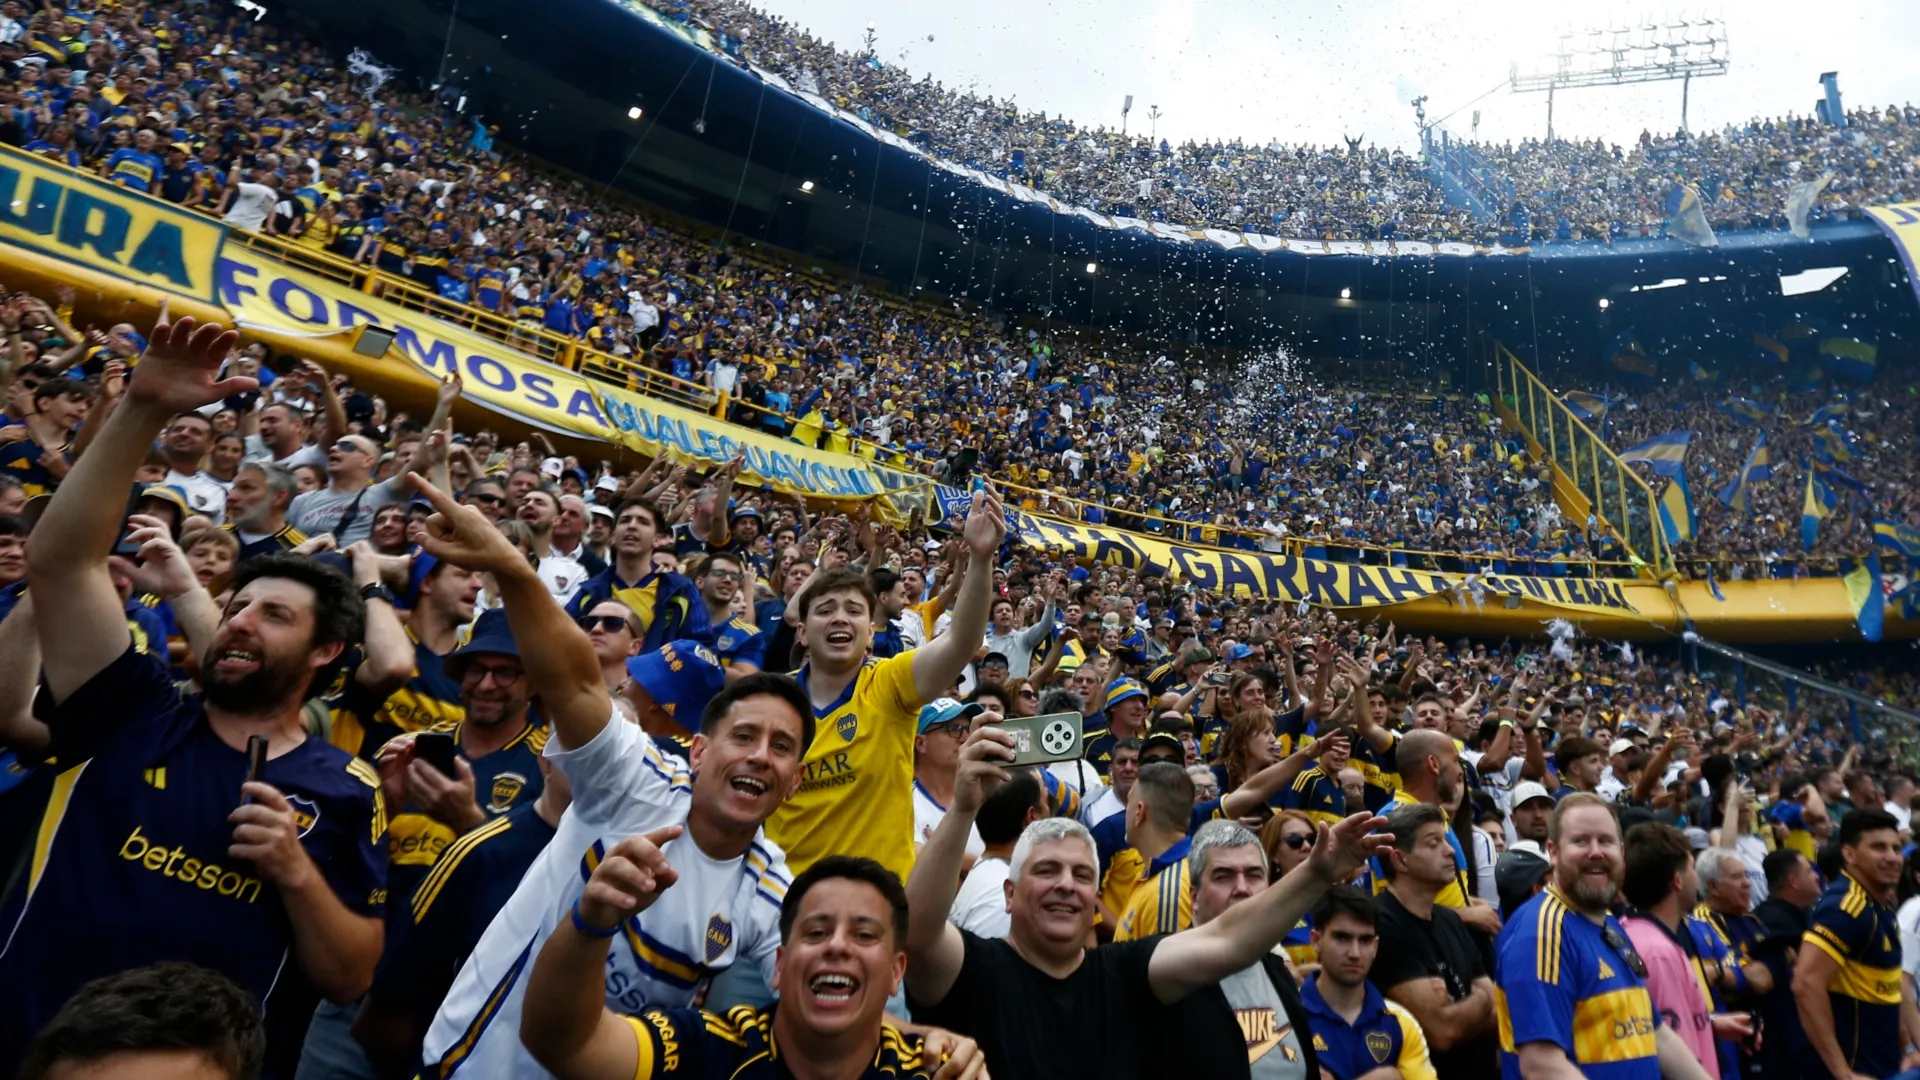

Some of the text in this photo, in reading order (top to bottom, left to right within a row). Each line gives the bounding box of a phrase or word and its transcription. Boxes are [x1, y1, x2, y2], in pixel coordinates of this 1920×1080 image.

[802, 752, 852, 781] TAR
[118, 825, 262, 904] betsson
[708, 931, 729, 947] CABJ
[1237, 1010, 1277, 1042] NIKE
